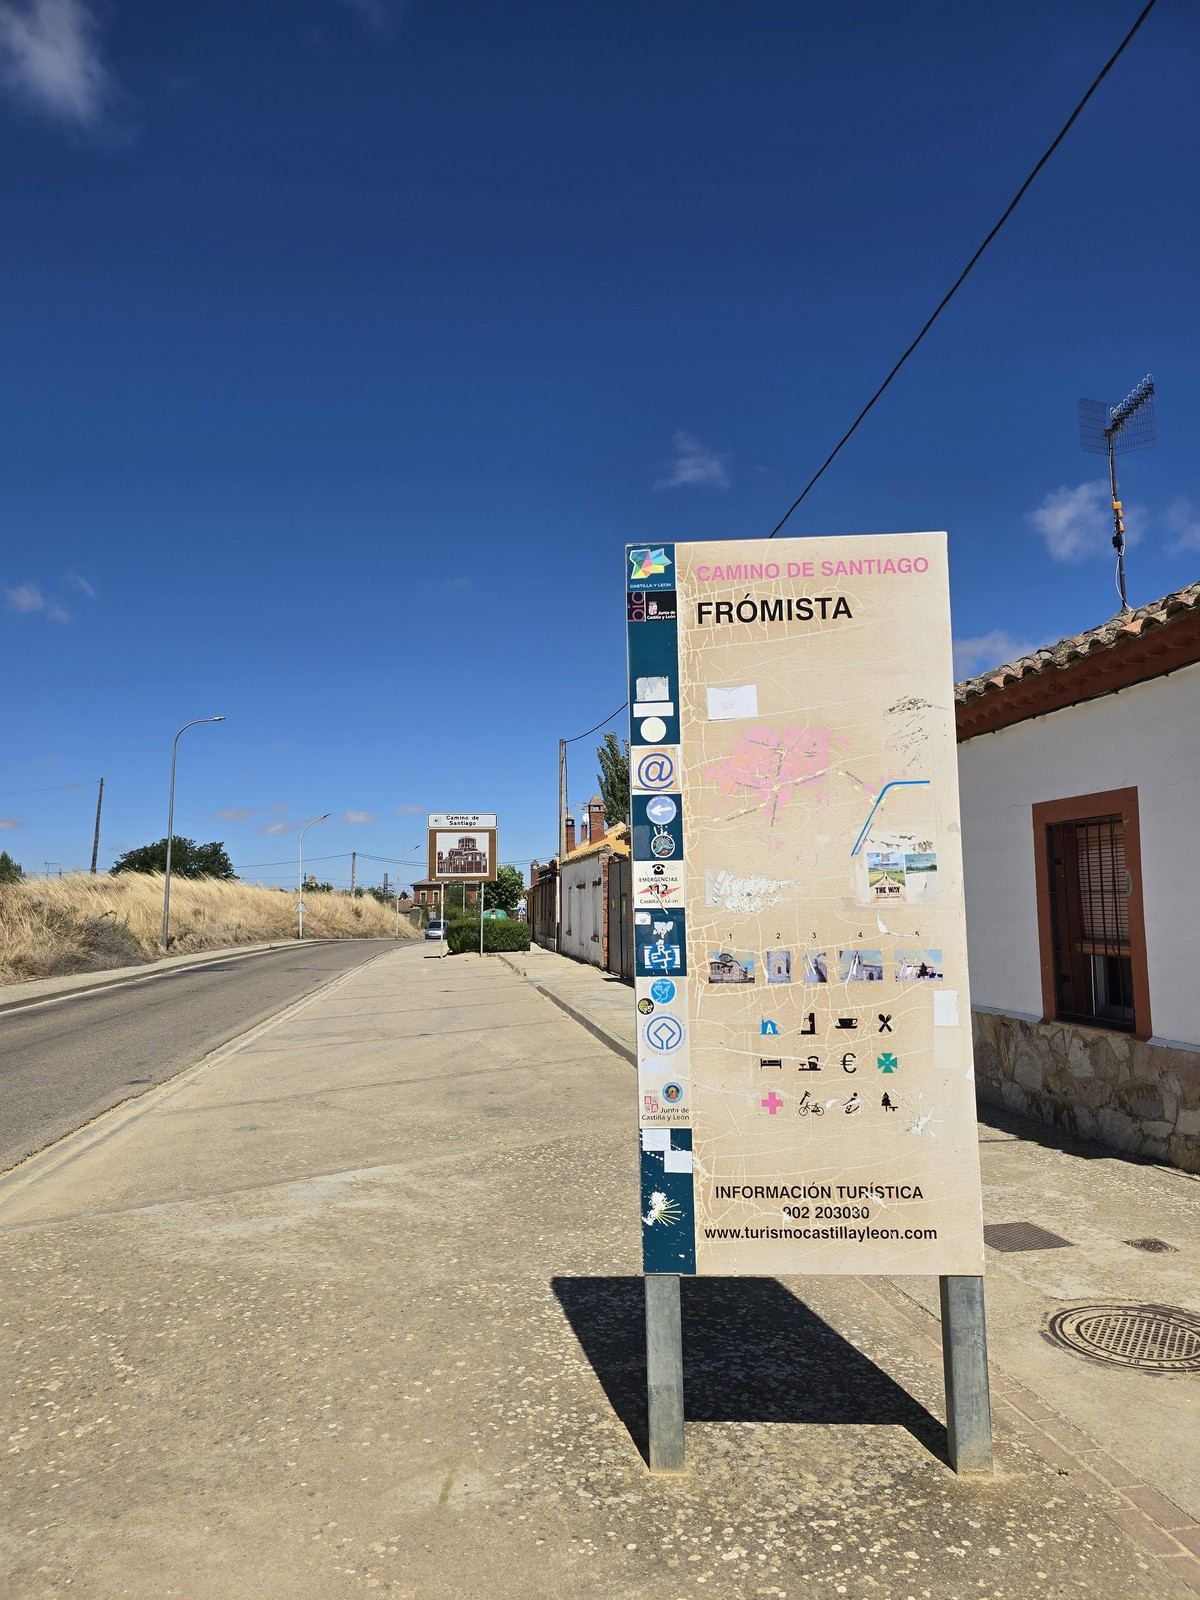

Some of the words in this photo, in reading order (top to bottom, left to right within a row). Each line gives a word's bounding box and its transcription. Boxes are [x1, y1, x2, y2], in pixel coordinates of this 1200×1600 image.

[696, 562, 780, 582] CAMINO
[787, 561, 815, 578] DE
[821, 556, 930, 577] SANTIAGO
[697, 593, 853, 625] FRÓMISTA
[715, 1183, 831, 1199] INFORMACIÓN
[836, 1182, 924, 1198] TURÍSTICA
[783, 1206, 810, 1218] 902
[816, 1206, 870, 1218] 203030
[704, 1226, 937, 1242] www.turismocastillayleon.com
